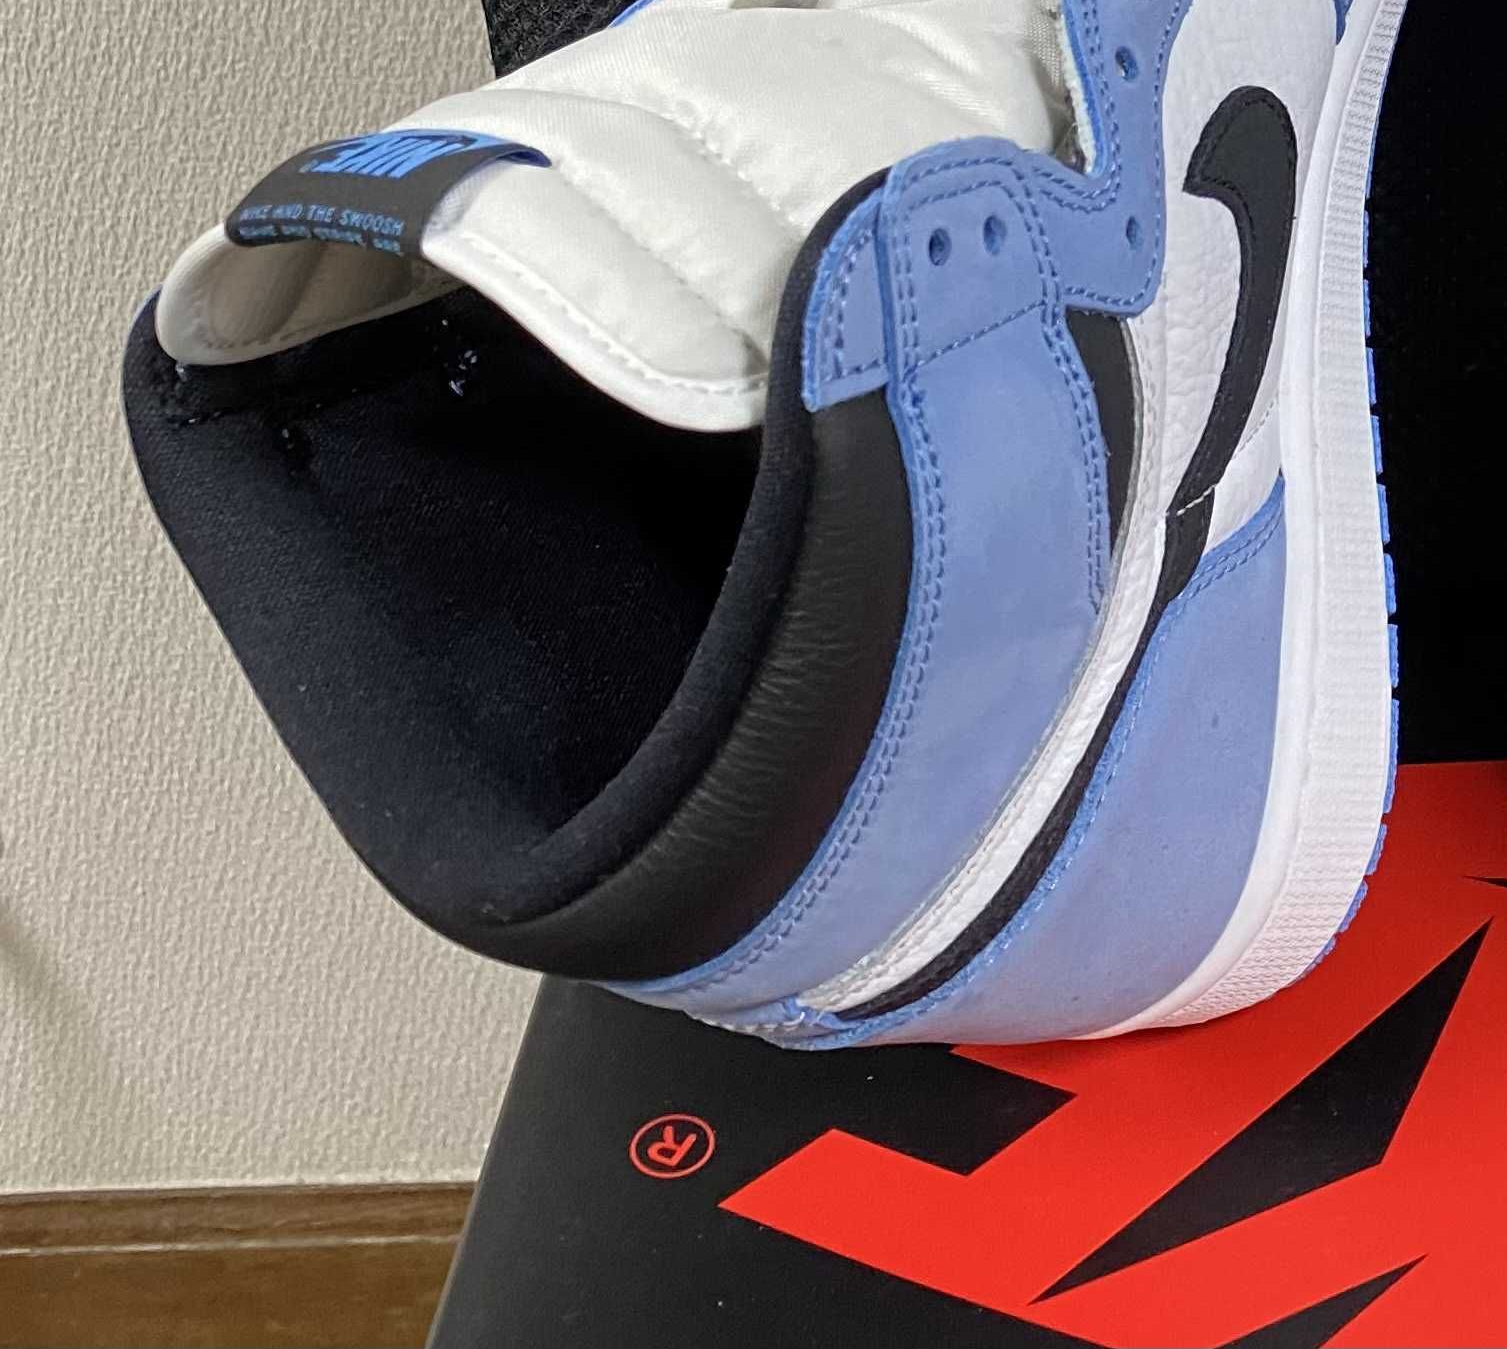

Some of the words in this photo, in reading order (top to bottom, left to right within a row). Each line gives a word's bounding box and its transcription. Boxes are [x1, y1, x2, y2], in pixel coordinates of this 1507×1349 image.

[272, 204, 304, 220] AND
[307, 204, 336, 223] THE
[339, 209, 405, 236] SWOOSH
